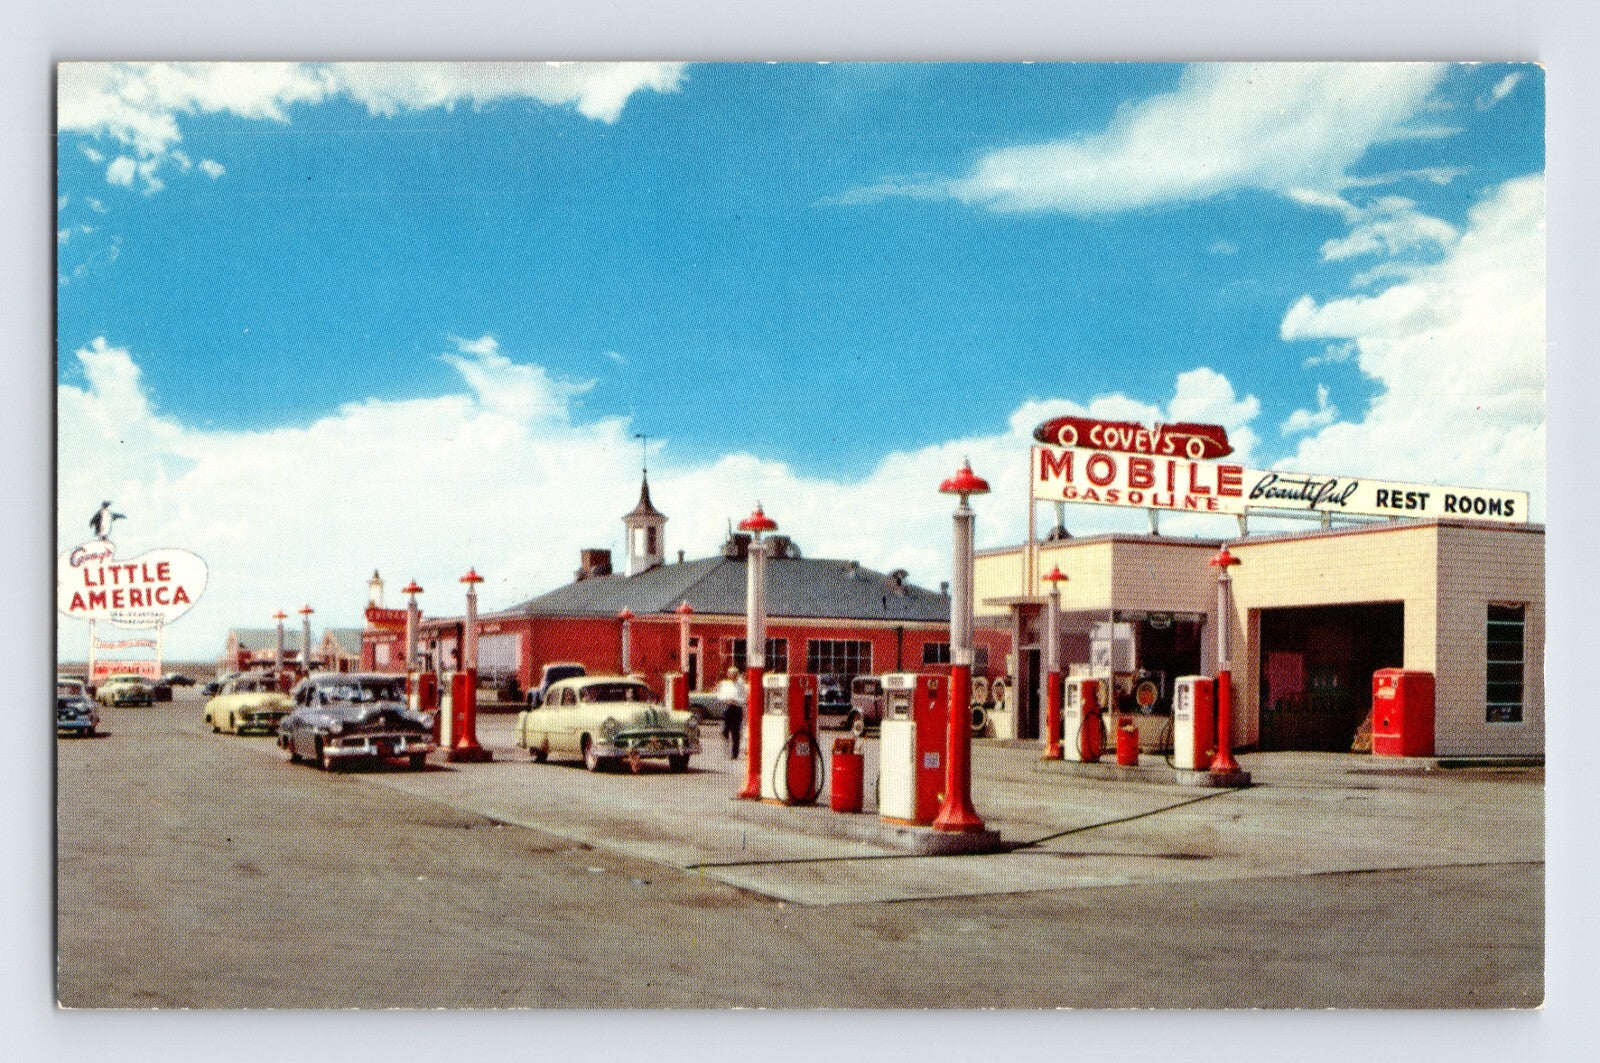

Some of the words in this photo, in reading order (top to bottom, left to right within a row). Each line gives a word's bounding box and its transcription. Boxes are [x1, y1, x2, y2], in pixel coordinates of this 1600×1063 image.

[1040, 448, 1243, 497] MOBILE
[1062, 485, 1219, 511] GASOLINE
[1249, 474, 1358, 509] Beautiful
[1376, 488, 1430, 511] REST
[1444, 493, 1515, 517] ROOMS
[84, 562, 171, 587] LITTLE
[70, 586, 190, 611] AMERICA
